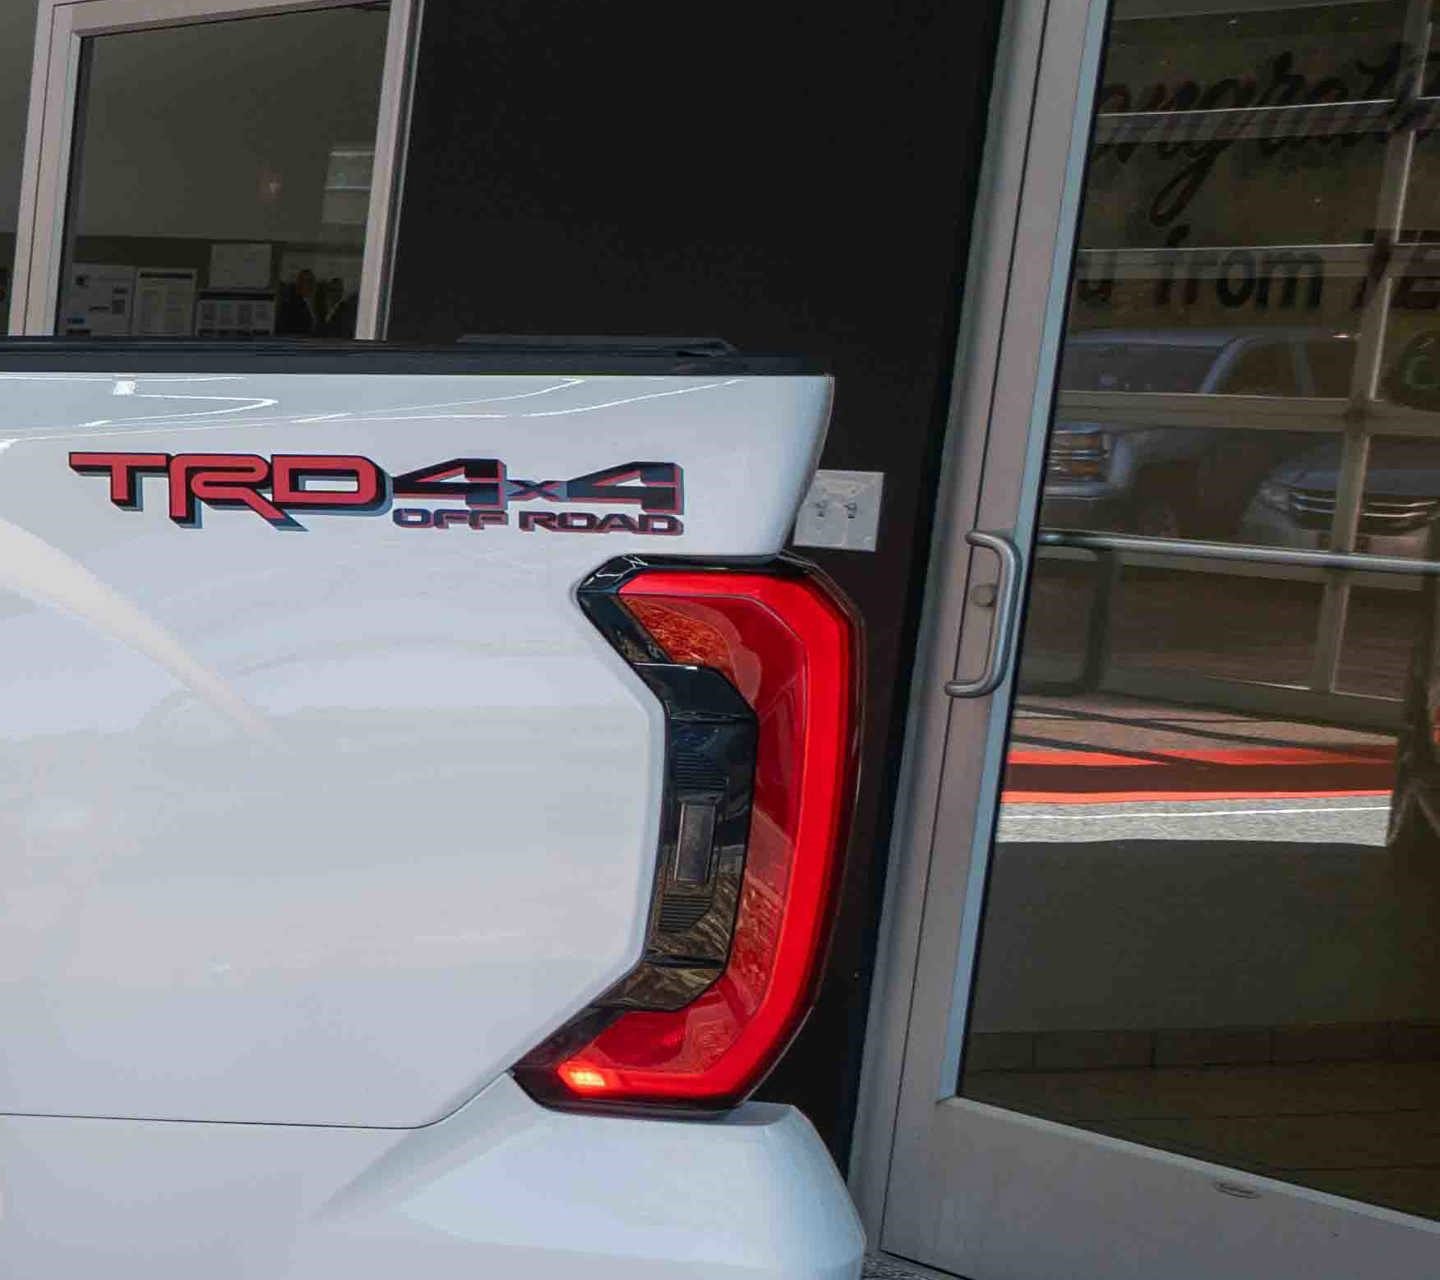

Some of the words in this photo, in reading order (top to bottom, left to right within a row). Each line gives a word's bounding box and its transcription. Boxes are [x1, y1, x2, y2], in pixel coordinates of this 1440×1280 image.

[68, 451, 392, 532] TRD
[391, 506, 509, 531] OFF
[517, 509, 685, 536] ROAD
